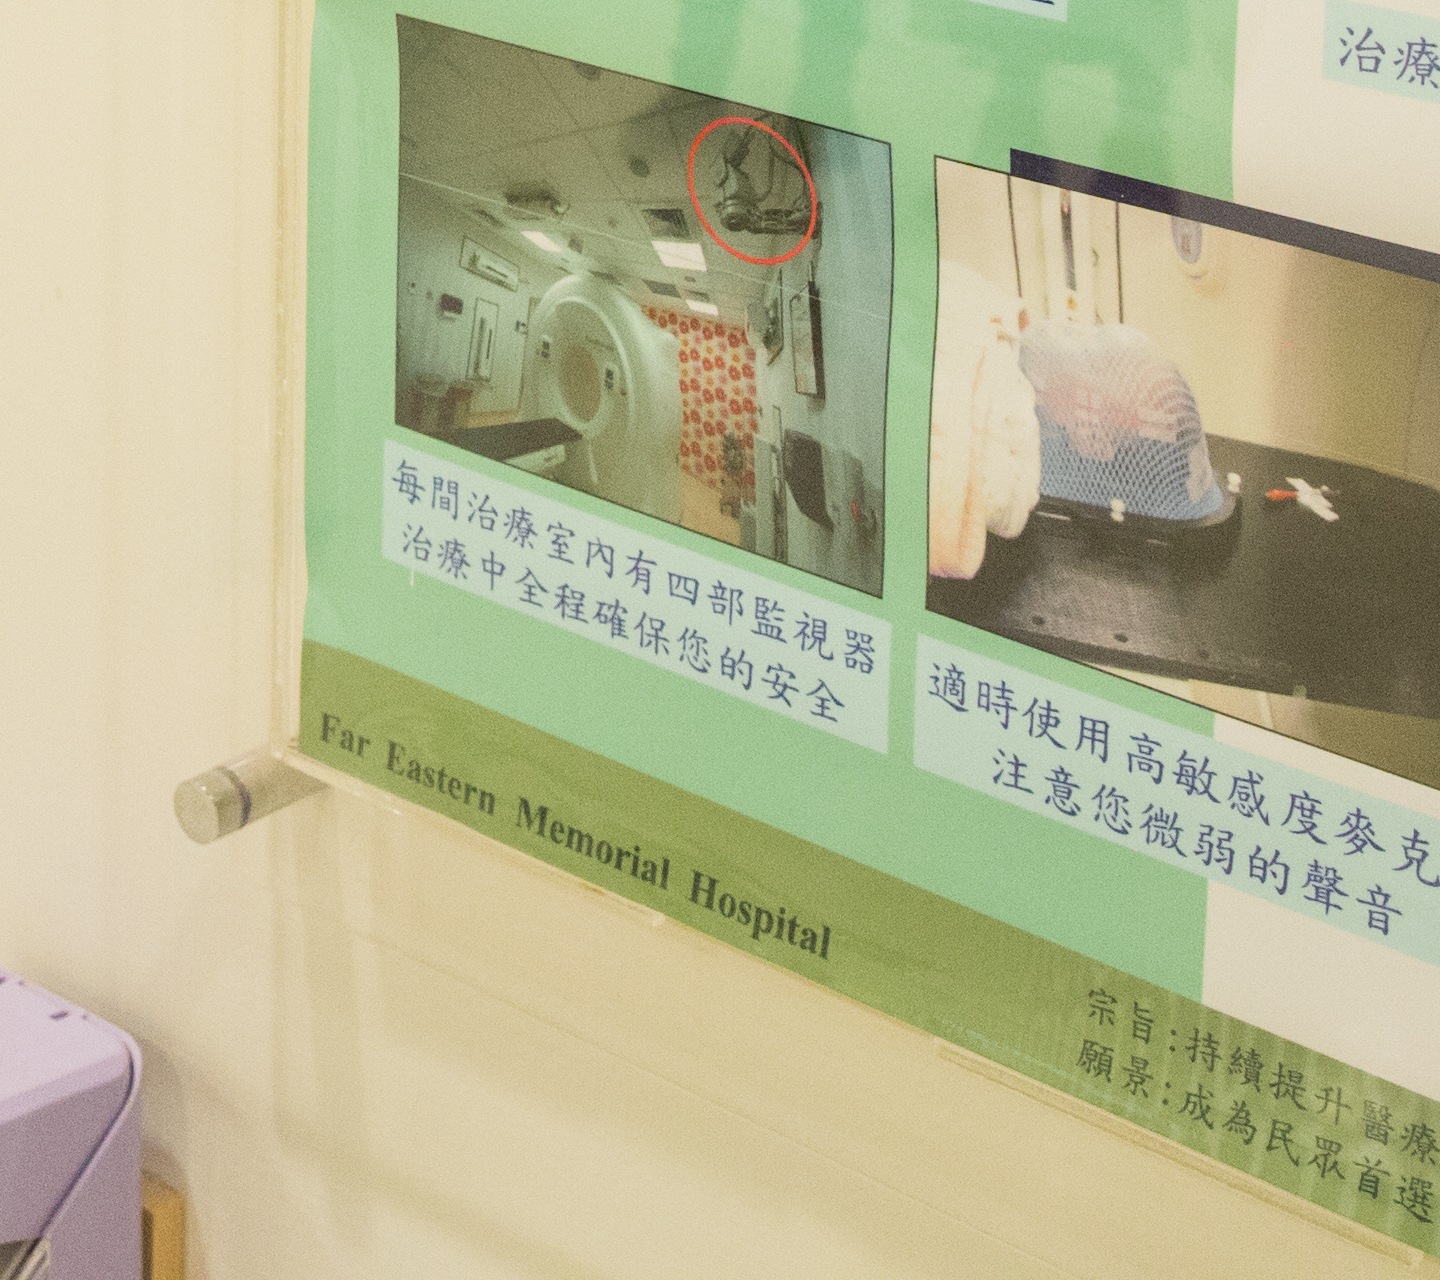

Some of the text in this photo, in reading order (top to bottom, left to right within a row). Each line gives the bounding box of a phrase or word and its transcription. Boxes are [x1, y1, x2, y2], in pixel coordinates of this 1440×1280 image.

[391, 459, 876, 675] 每間治療室內有四部監視器
[401, 522, 846, 723] 治療中全程確保您的安全
[319, 711, 833, 960] Far Eastern Memorial Hospital
[990, 749, 1403, 937] 注意您微弱的聲音
